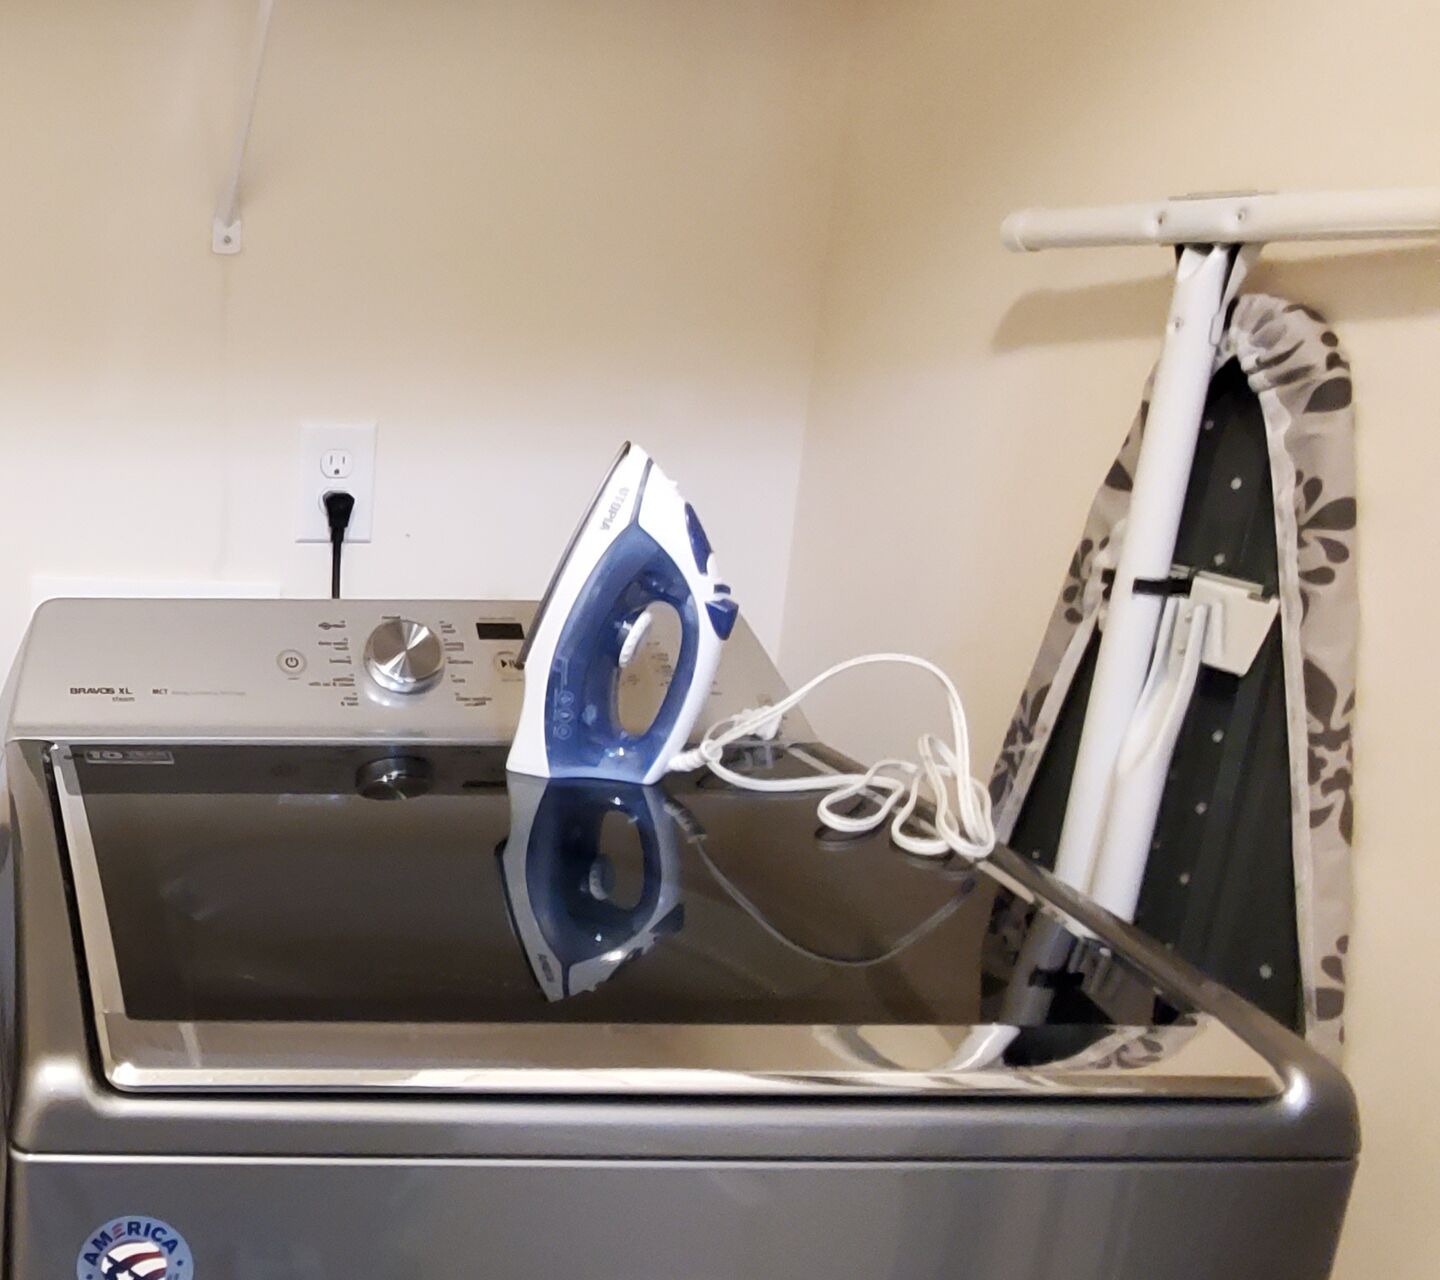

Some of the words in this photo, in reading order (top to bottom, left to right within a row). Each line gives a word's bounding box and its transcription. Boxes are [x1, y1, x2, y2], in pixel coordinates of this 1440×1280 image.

[600, 487, 630, 530] UTOPIA
[70, 687, 115, 695] BRAVOS
[118, 687, 133, 695] XL
[83, 1221, 178, 1266] AMERICA
